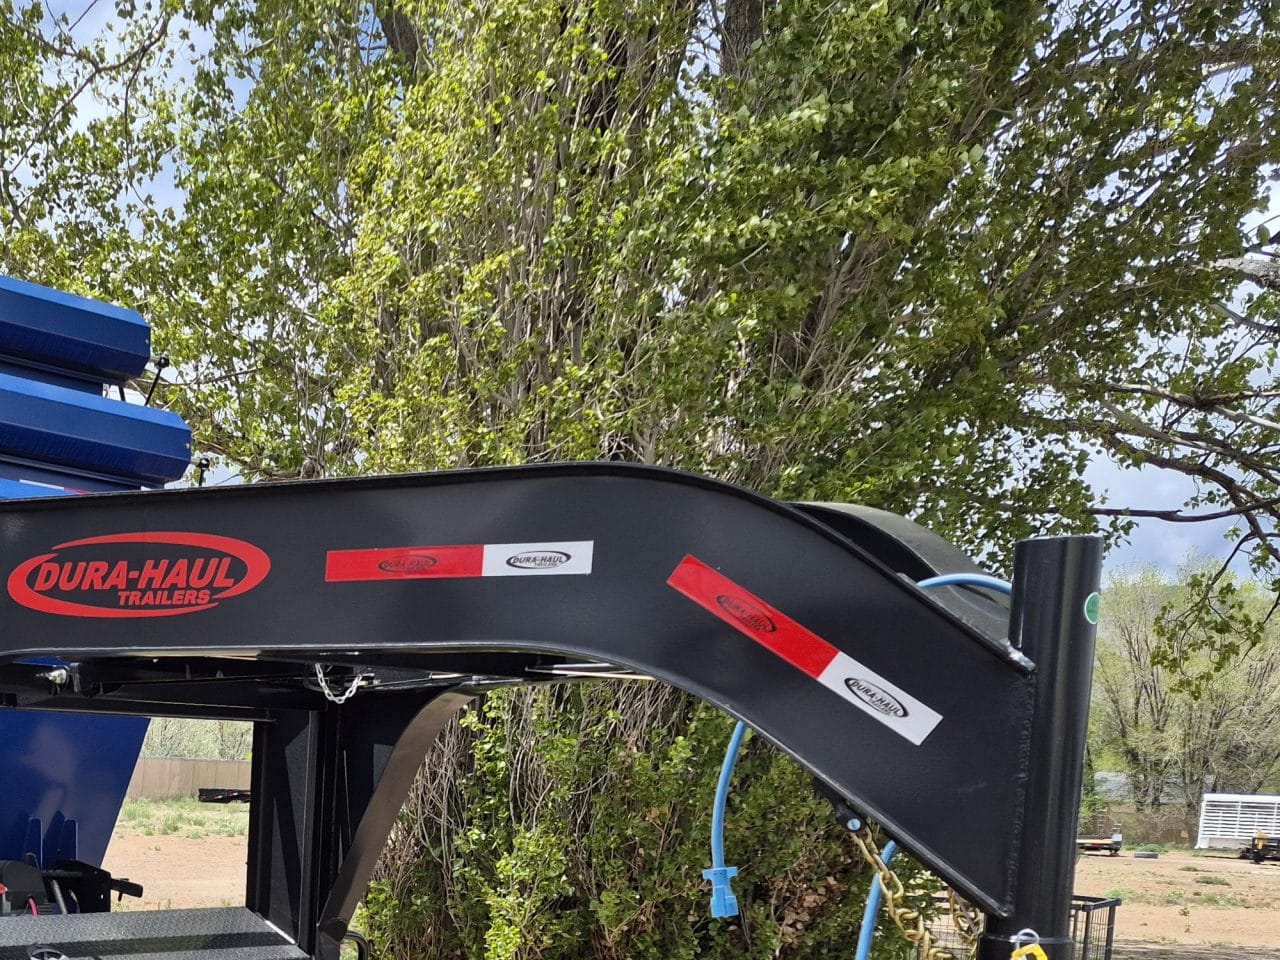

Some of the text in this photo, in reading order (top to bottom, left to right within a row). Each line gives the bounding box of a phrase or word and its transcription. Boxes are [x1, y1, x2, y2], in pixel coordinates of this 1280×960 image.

[513, 555, 563, 564] DURA-HAUL
[34, 557, 236, 591] DURA-HAUL
[117, 589, 211, 606] TRAILERS
[850, 681, 901, 714] DURA-HAUL
